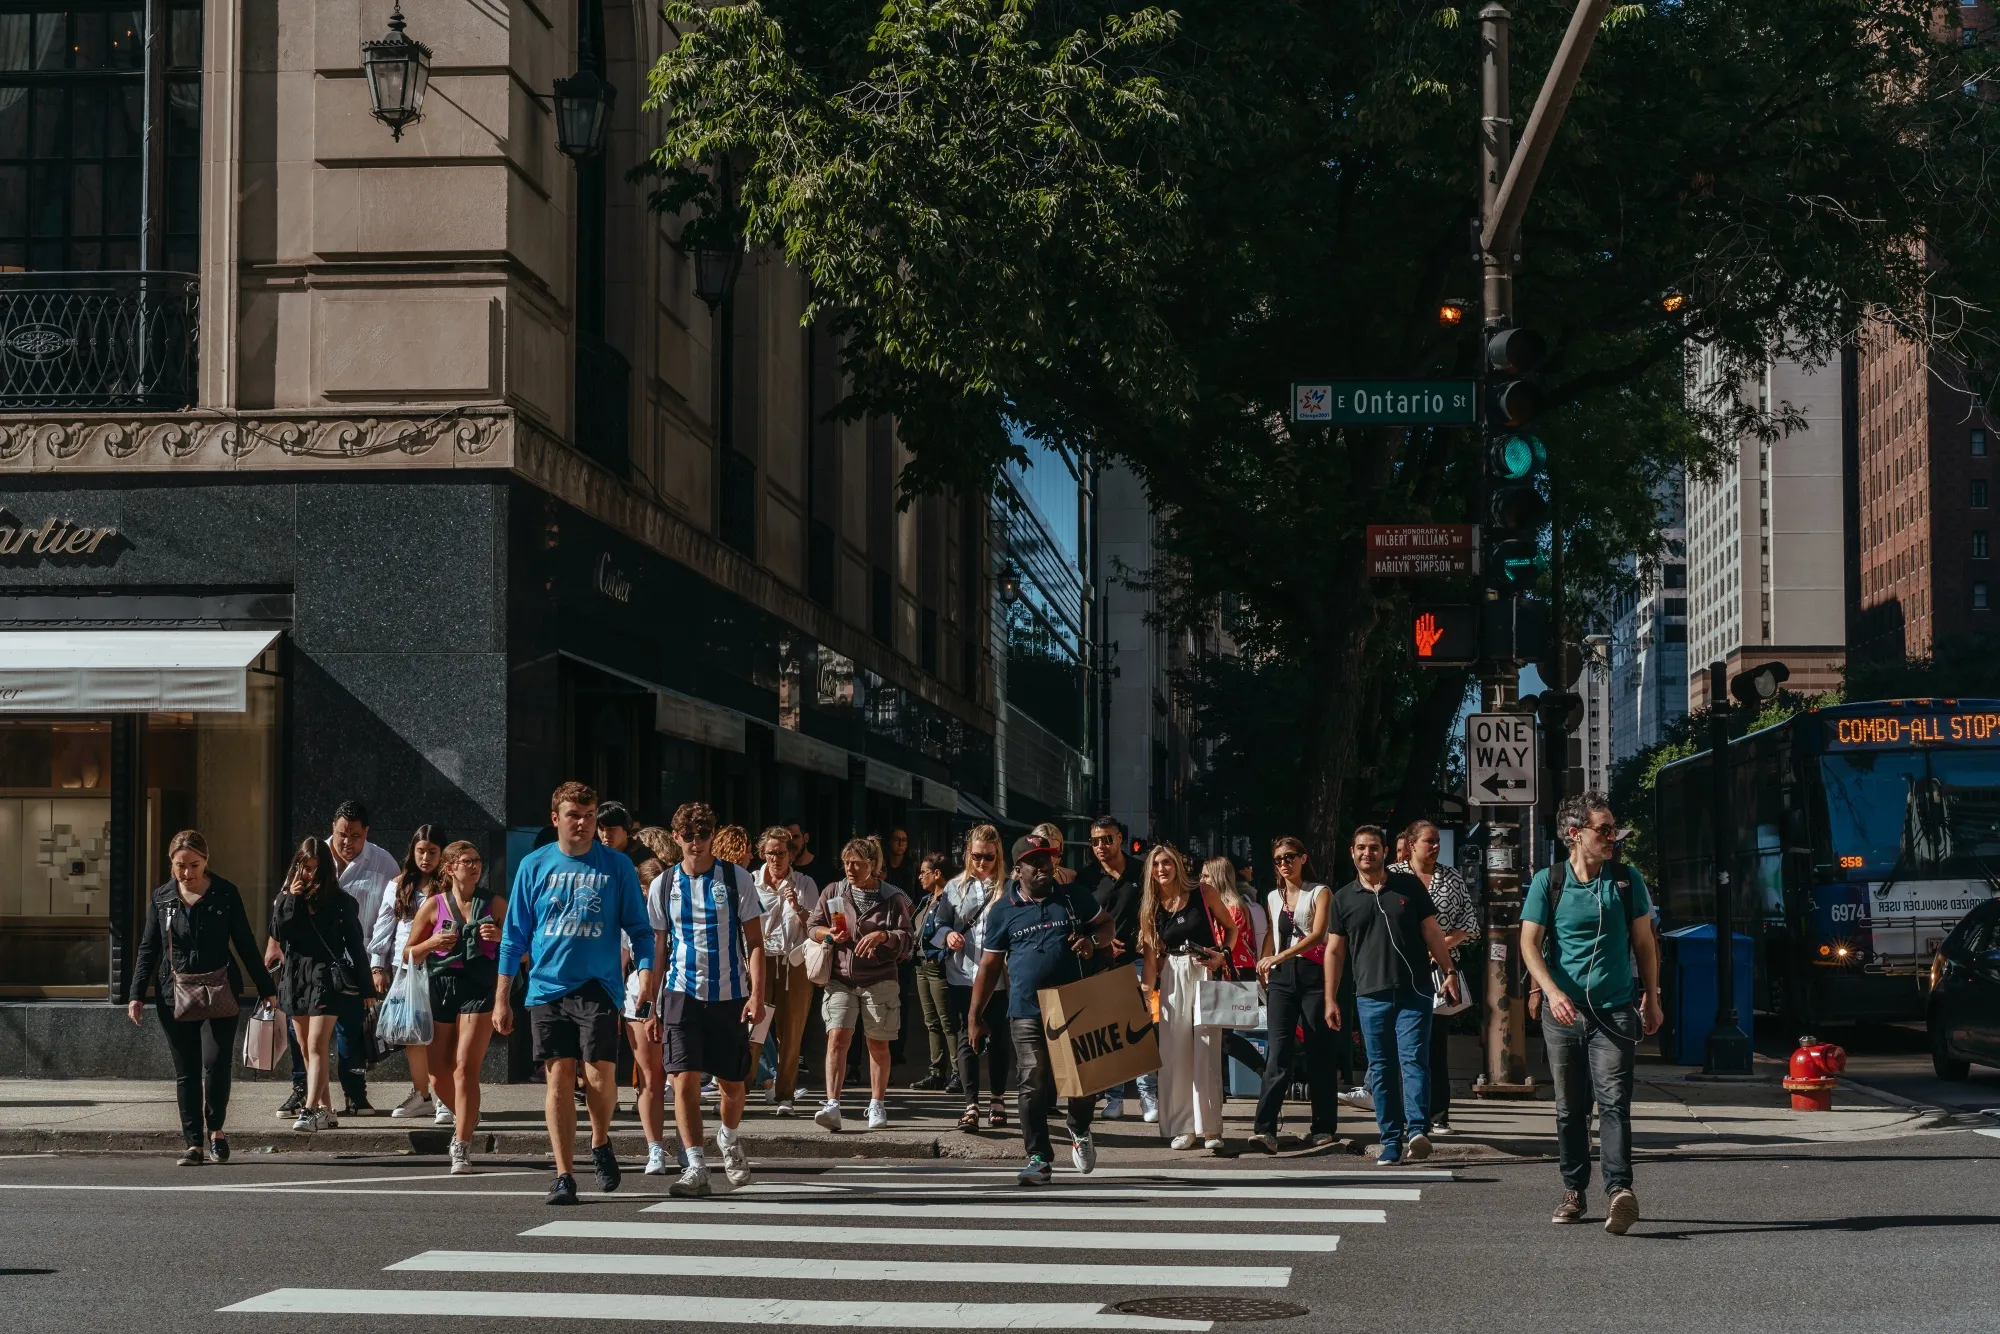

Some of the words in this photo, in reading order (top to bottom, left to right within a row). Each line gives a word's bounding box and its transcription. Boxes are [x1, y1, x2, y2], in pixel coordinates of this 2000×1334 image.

[1338, 395, 1345, 408] E
[1354, 389, 1443, 414] Ontario
[1453, 395, 1466, 408] St
[0, 507, 117, 554] artier
[1375, 534, 1408, 546] WILBERT
[1412, 534, 1449, 546] WILLIAMS
[1452, 536, 1463, 544] WAY
[1375, 561, 1410, 573] MARILYN
[1415, 560, 1451, 572] SIMPSON
[1454, 562, 1465, 570] WAY
[1477, 722, 1527, 743] ONE
[1838, 717, 1945, 743] COMBO-ALL
[1476, 747, 1529, 768] WAY
[1840, 856, 1863, 868] 358
[547, 872, 611, 889] DETROIT
[1831, 903, 1866, 922] 6974
[544, 918, 604, 938] LIONS
[1013, 924, 1042, 938] TOMMY
[1231, 1004, 1252, 1012] maje
[1069, 1022, 1124, 1065] NIKE
